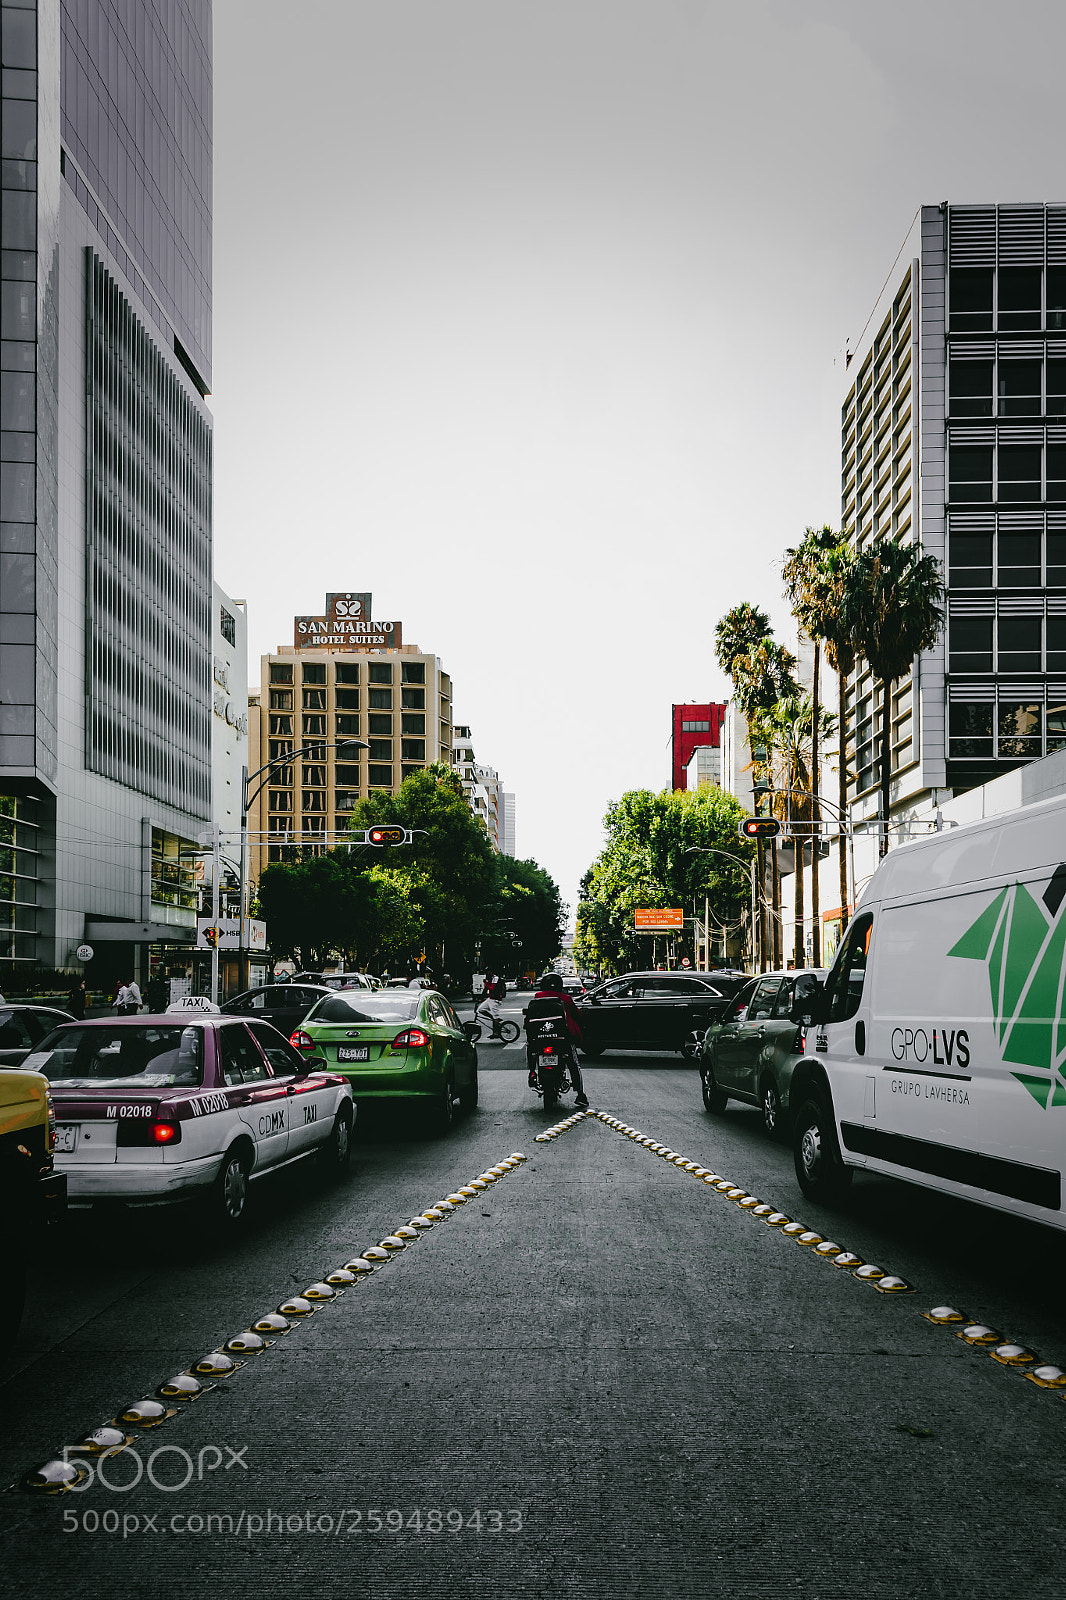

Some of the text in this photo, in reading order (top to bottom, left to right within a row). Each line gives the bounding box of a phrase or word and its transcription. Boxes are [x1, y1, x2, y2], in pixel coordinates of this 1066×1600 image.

[298, 621, 394, 634] SAN MARINO
[312, 636, 385, 645] HOTEL SUITES
[182, 998, 204, 1007] TAXI
[892, 1080, 970, 1105] GRUPO LAVHERSA
[106, 1105, 152, 1118] M 02018
[189, 1093, 229, 1117] M 02018
[303, 1104, 317, 1124] TAXI
[259, 1110, 285, 1135] CDMX
